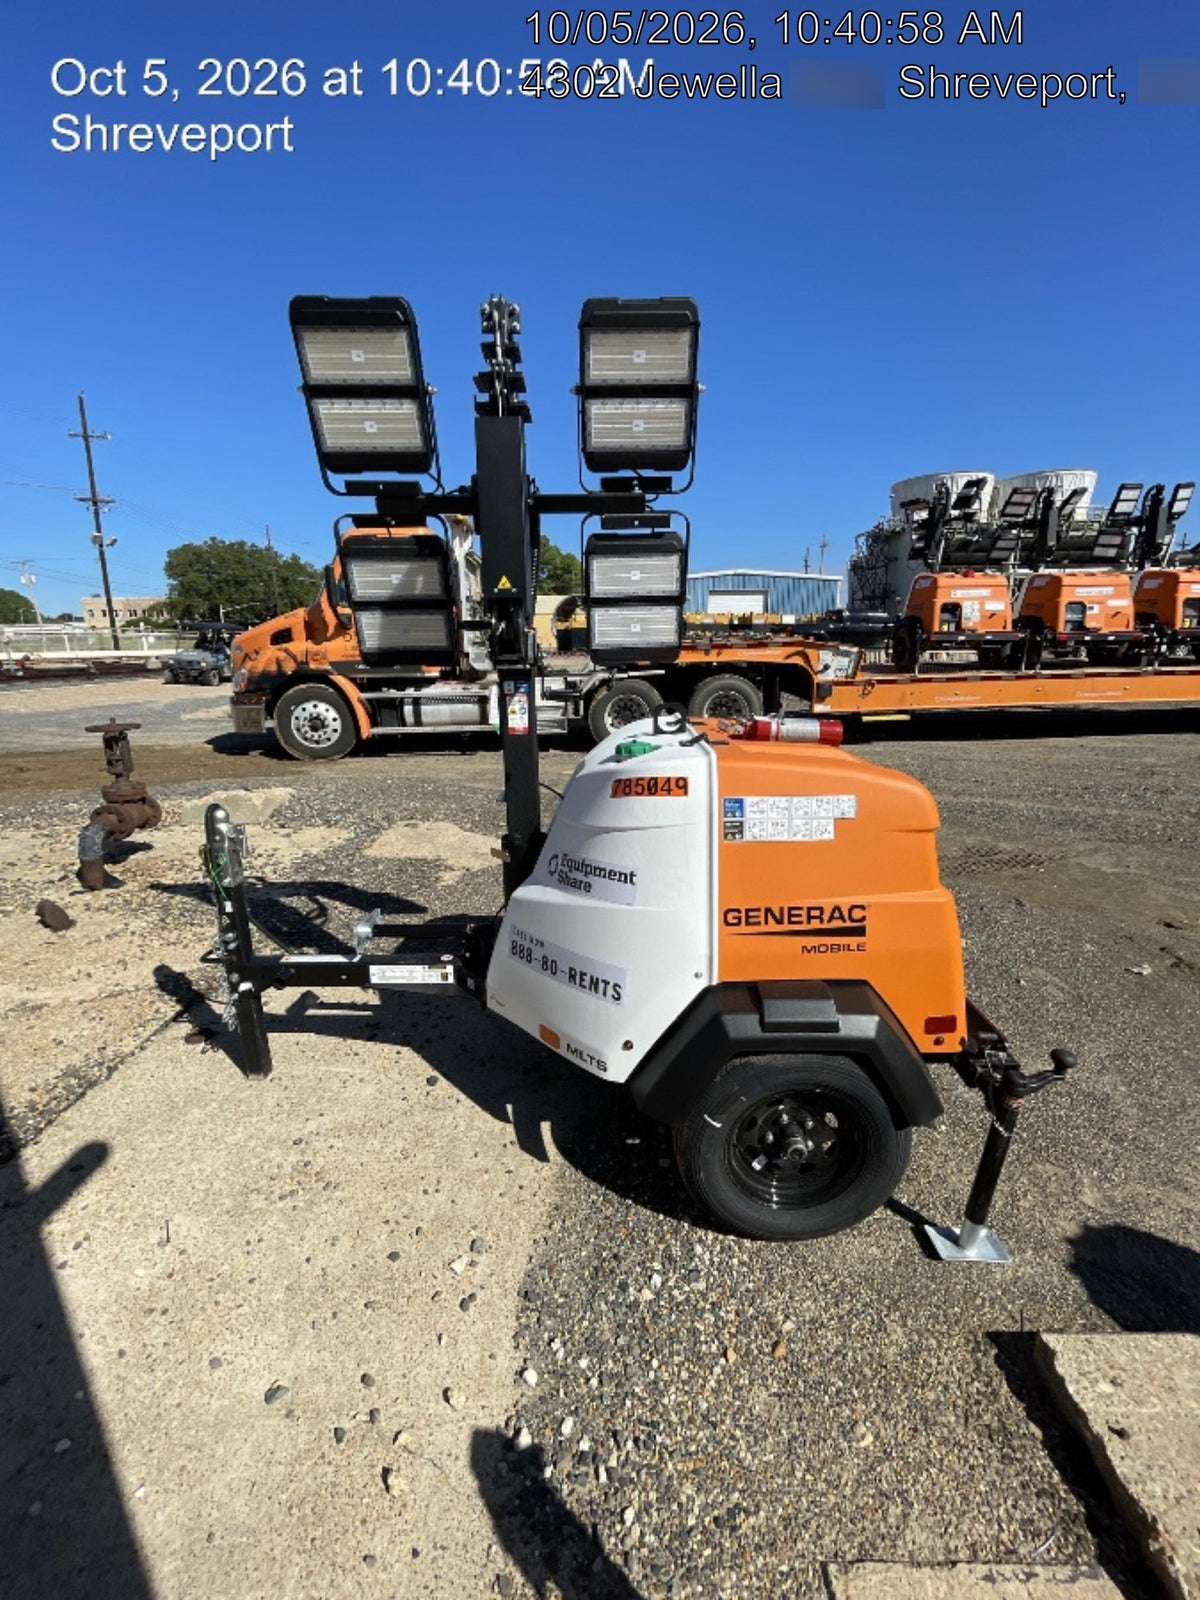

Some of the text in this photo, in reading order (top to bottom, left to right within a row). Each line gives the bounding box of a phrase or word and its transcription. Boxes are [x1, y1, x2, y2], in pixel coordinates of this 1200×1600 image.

[611, 776, 688, 797] 785049
[557, 869, 593, 893] Share
[560, 853, 637, 886] Equipment
[723, 904, 867, 927] GENERAC
[801, 942, 867, 954] MOBILE
[511, 940, 622, 1001] 888-80-RENTS
